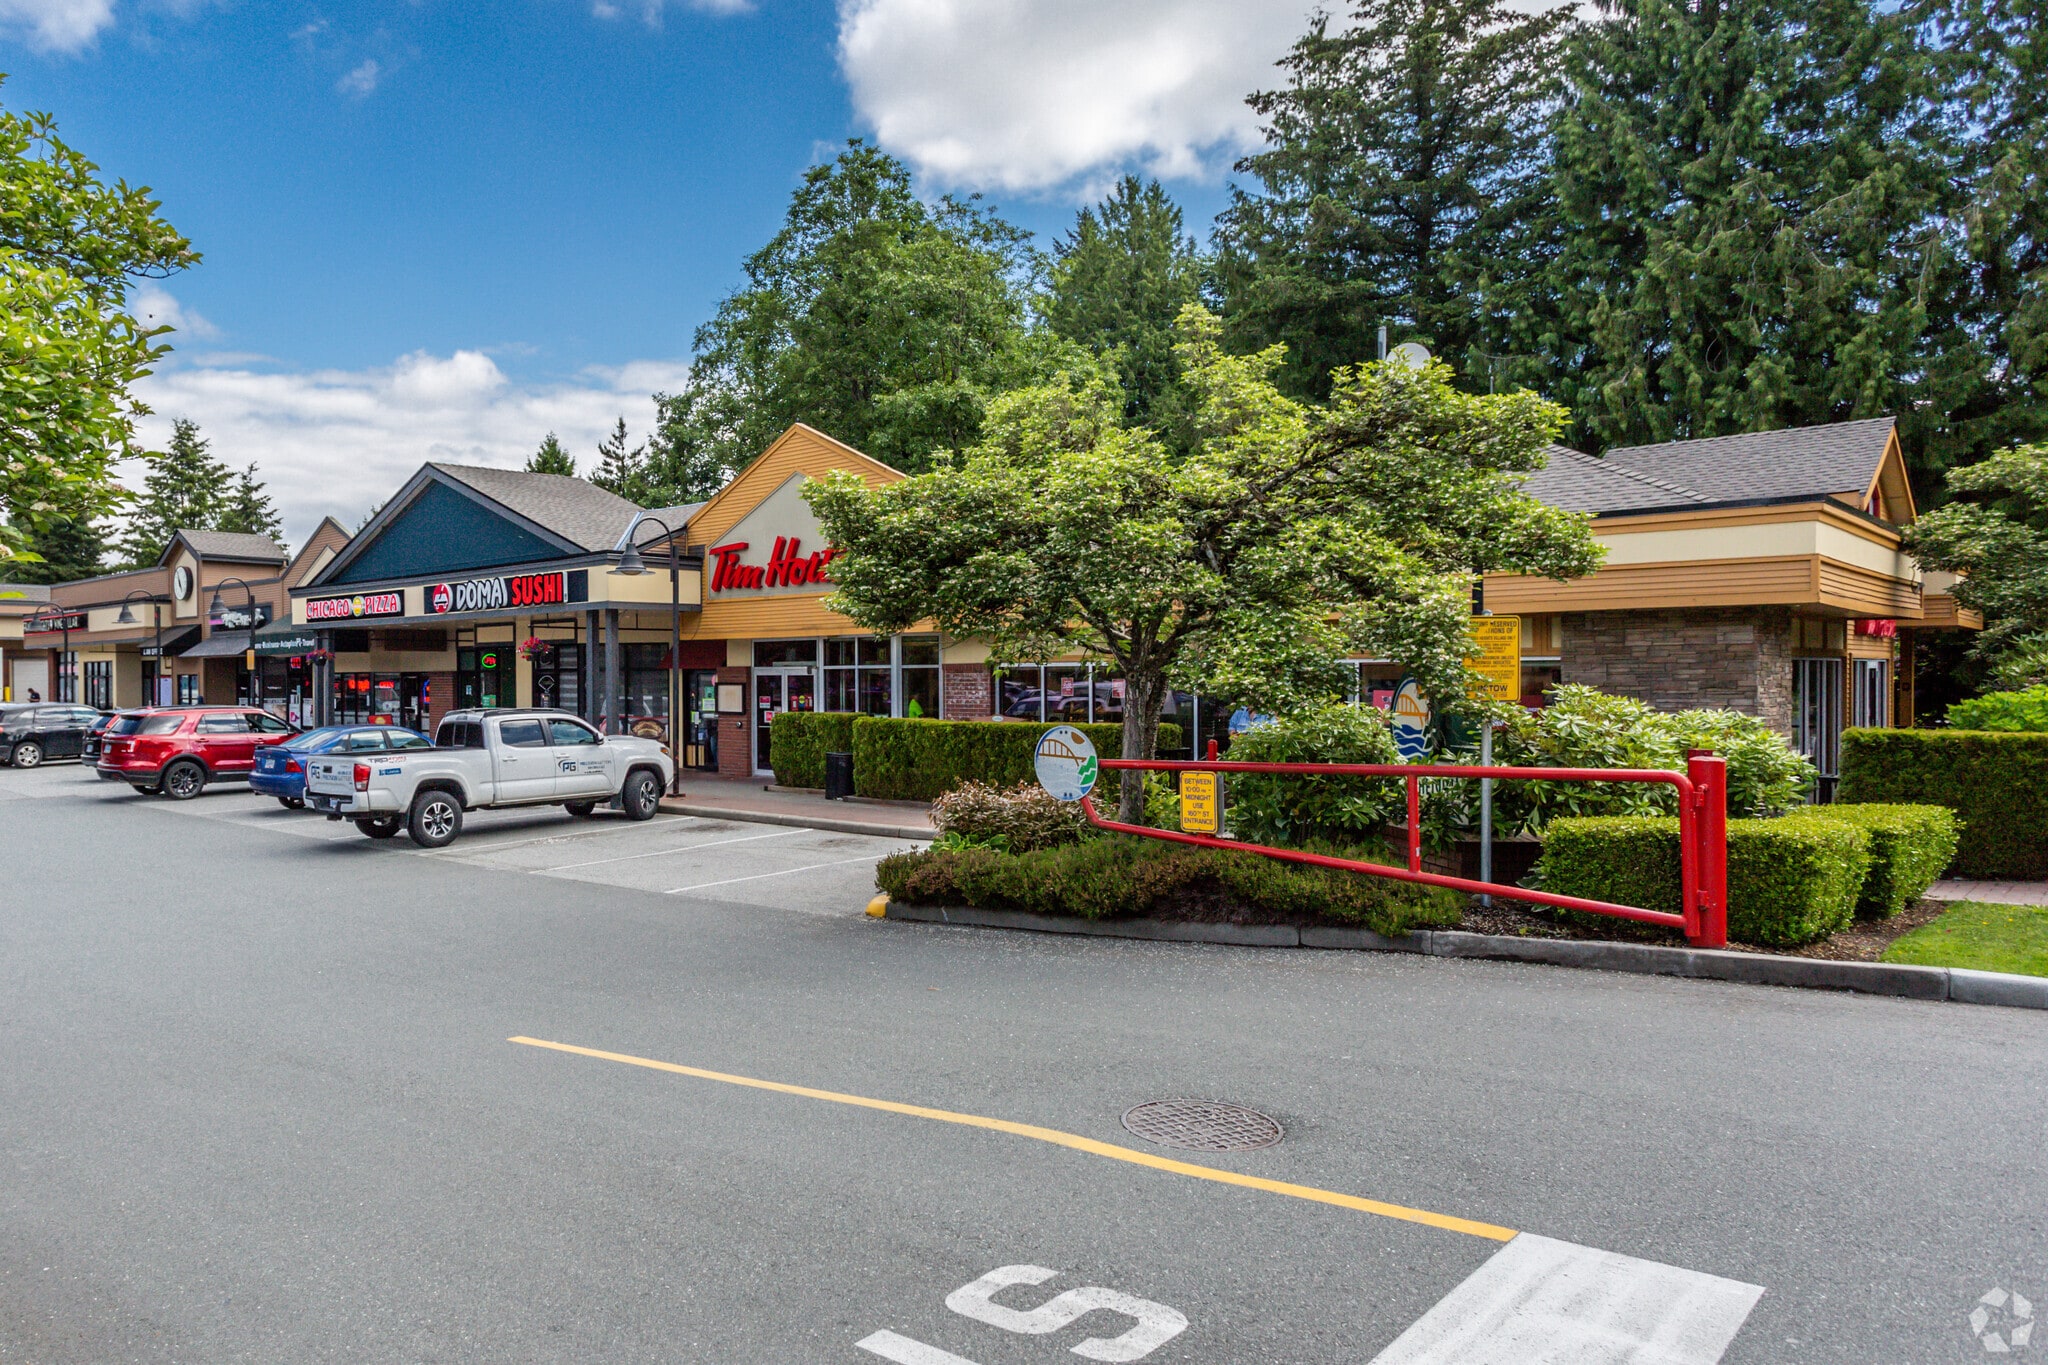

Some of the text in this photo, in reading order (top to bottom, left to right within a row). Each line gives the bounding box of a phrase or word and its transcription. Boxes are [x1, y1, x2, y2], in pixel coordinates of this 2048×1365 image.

[709, 535, 847, 592] Tim Hort
[306, 593, 400, 619] CHICAGO PIZZA
[456, 572, 564, 610] DOMA SUSHI
[1184, 817, 1213, 825] ENTRANCE
